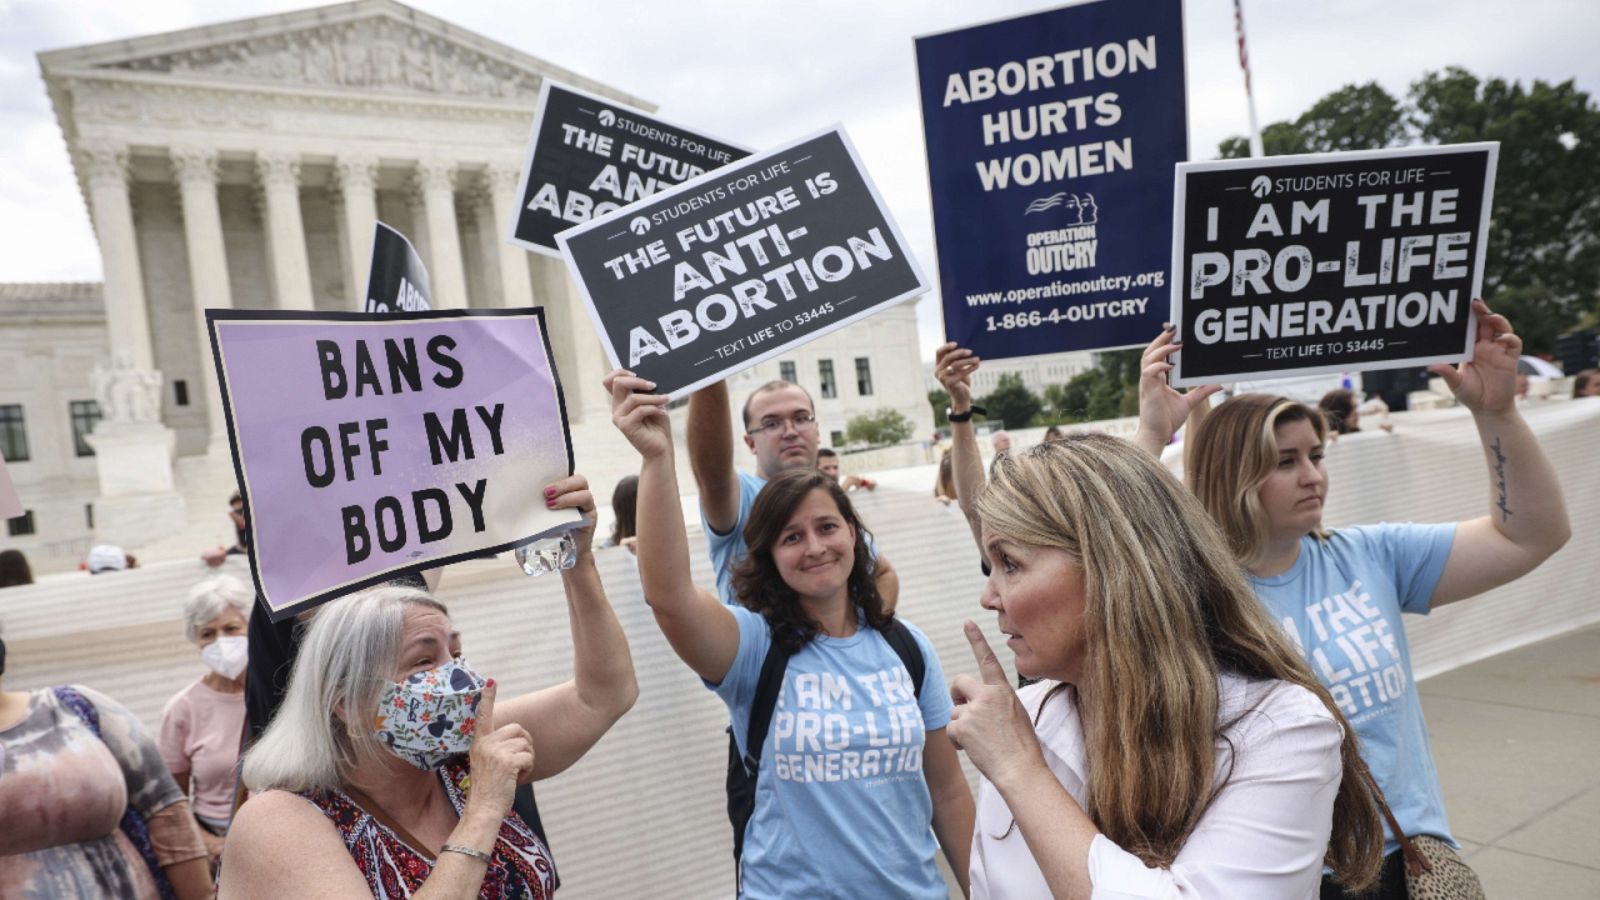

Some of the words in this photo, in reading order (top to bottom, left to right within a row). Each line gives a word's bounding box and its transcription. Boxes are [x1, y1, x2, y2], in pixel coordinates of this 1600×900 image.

[942, 35, 1157, 107] ABORTION
[618, 118, 679, 147] STUDENTS
[680, 138, 707, 156] FOR
[708, 146, 732, 164] LIFE
[982, 92, 1122, 146] HURTS
[562, 123, 612, 157] THE
[621, 143, 715, 181] FUTUR
[975, 137, 1133, 191] WOMEN
[652, 189, 726, 226] STUDENTS
[727, 174, 760, 194] FOR
[760, 161, 790, 181] LIFE
[1276, 173, 1354, 193] STUDENTS
[1359, 171, 1390, 186] FOR
[1395, 169, 1425, 184] LIFE
[604, 240, 671, 280] THE
[676, 186, 801, 253] FUTURE
[805, 171, 839, 199] IS
[1026, 226, 1096, 246] OPERATION
[1206, 207, 1218, 242] I
[1246, 199, 1330, 239] AM
[1358, 188, 1459, 229] THE
[673, 223, 809, 301] ANTI-
[1026, 240, 1098, 275] OUTCRY
[1190, 232, 1471, 300] PRO-LIFE
[628, 227, 893, 368] ABORTION
[966, 270, 1164, 307] www.operationoutcry.org
[987, 297, 1149, 331] 1-866-4-OUTCRY
[1194, 289, 1458, 345] GENERATION
[715, 338, 746, 360] TEXT
[747, 327, 776, 347] LIFE
[774, 320, 794, 335] TO
[795, 302, 835, 326] 53445
[1266, 347, 1293, 359] TEXT
[1298, 344, 1324, 357] LIFE
[1326, 343, 1343, 354] TO
[1346, 338, 1384, 353] 53445
[316, 335, 464, 400] BANS
[301, 418, 389, 488] OFF
[424, 404, 505, 465] MY
[342, 479, 486, 565] BODY
[1306, 579, 1380, 642] THE
[796, 672, 852, 710] AM
